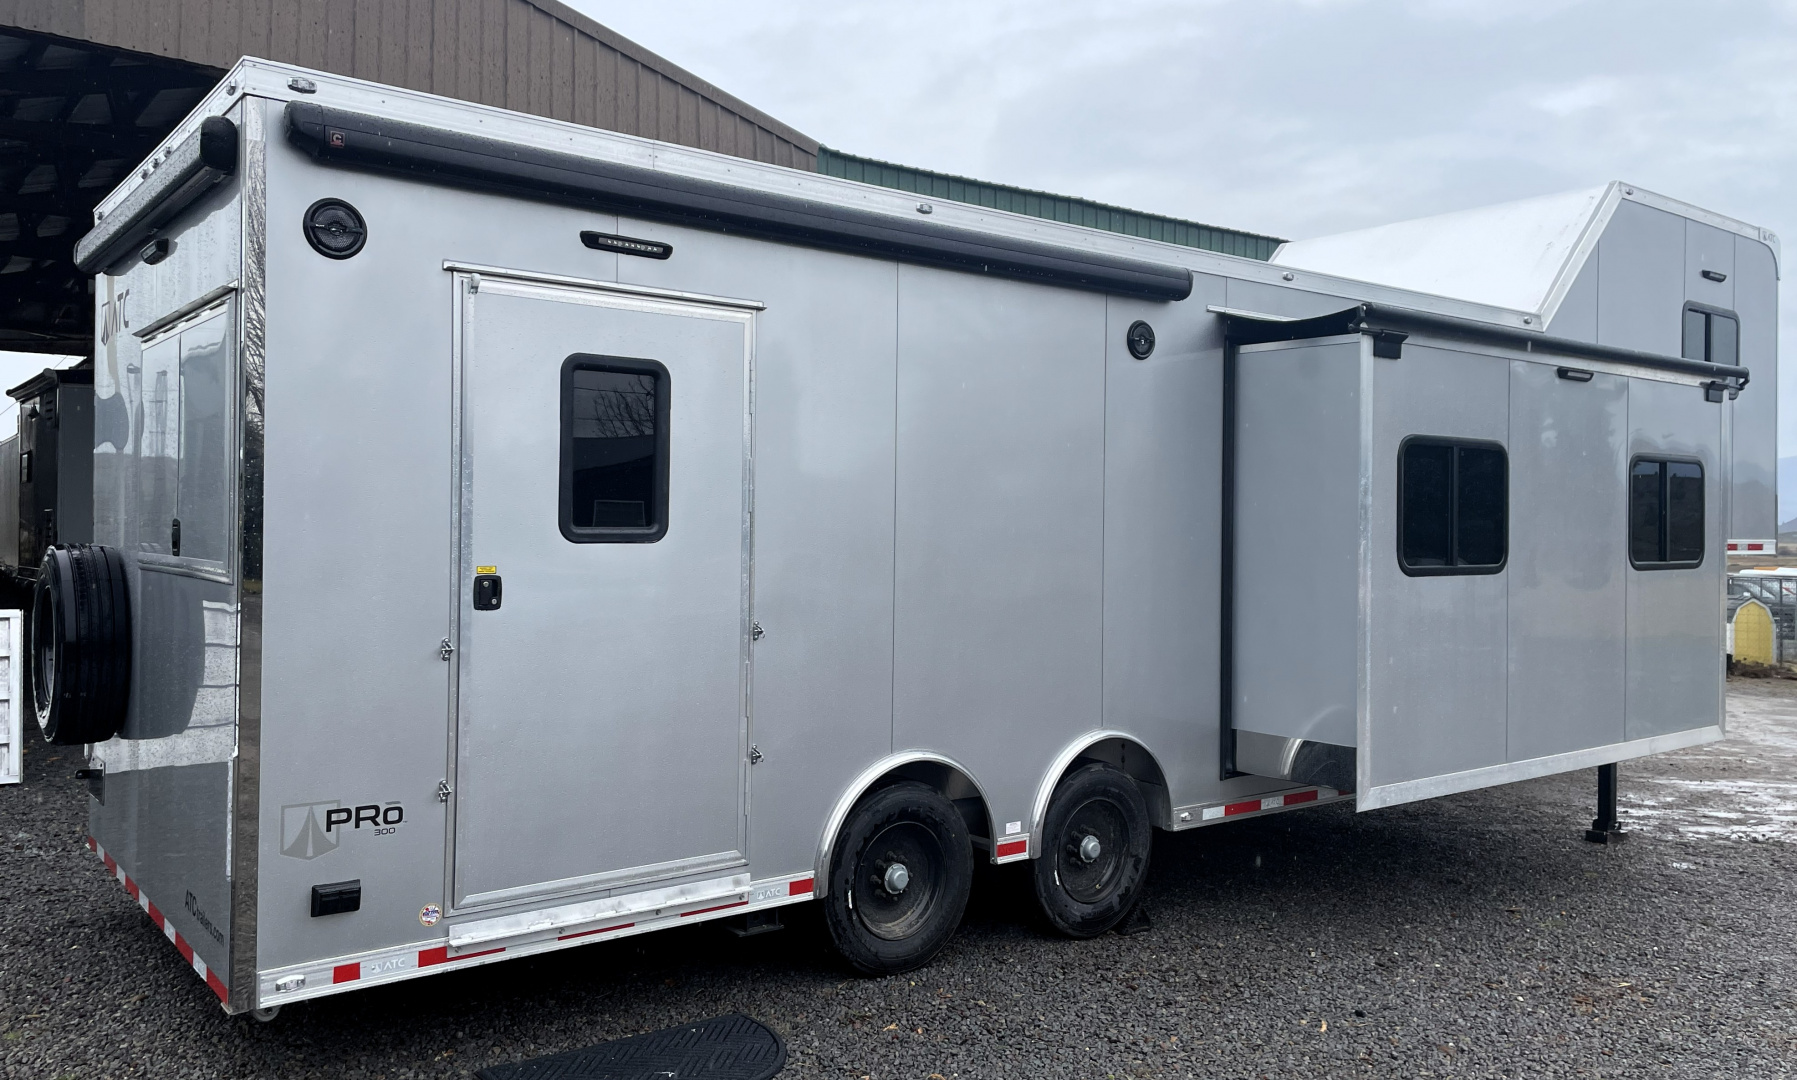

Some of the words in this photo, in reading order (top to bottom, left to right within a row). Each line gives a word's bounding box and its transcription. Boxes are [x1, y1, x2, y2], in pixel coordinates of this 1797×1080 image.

[110, 288, 130, 336] ATC
[374, 827, 396, 836] 300
[764, 887, 781, 898] ATC
[383, 957, 406, 970] ATC
